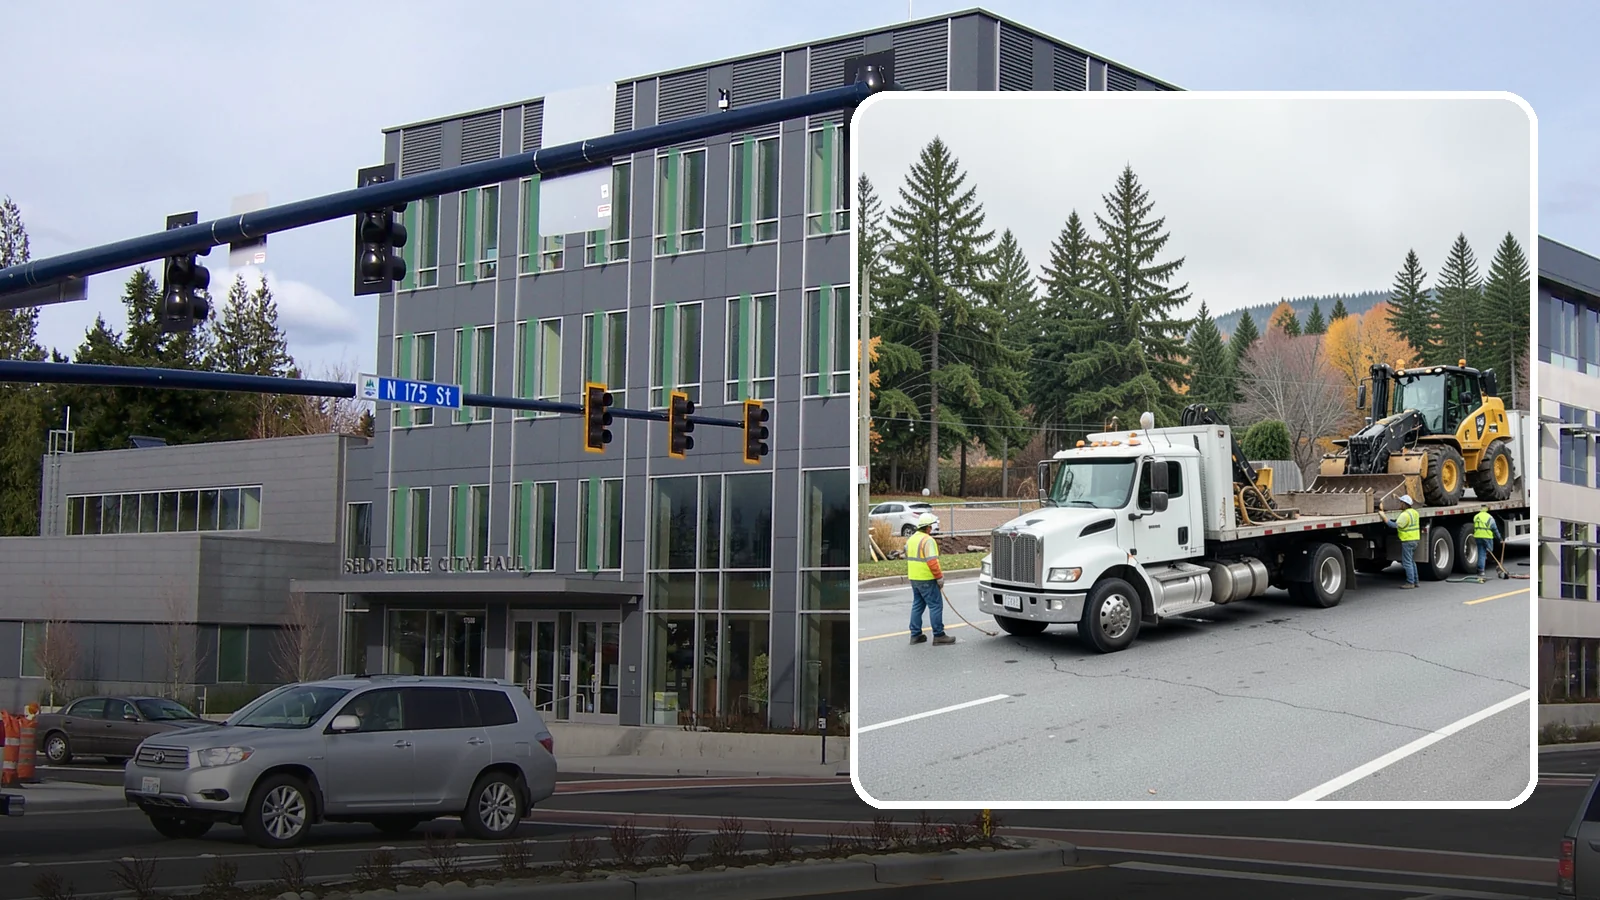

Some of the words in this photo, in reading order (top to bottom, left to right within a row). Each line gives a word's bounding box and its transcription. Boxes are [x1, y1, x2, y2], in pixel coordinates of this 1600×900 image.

[387, 380, 396, 399] N
[405, 382, 427, 403] 175
[436, 386, 451, 406] St
[343, 557, 432, 573] SHORELINE
[438, 556, 475, 572] CITY
[484, 555, 526, 571] HALL
